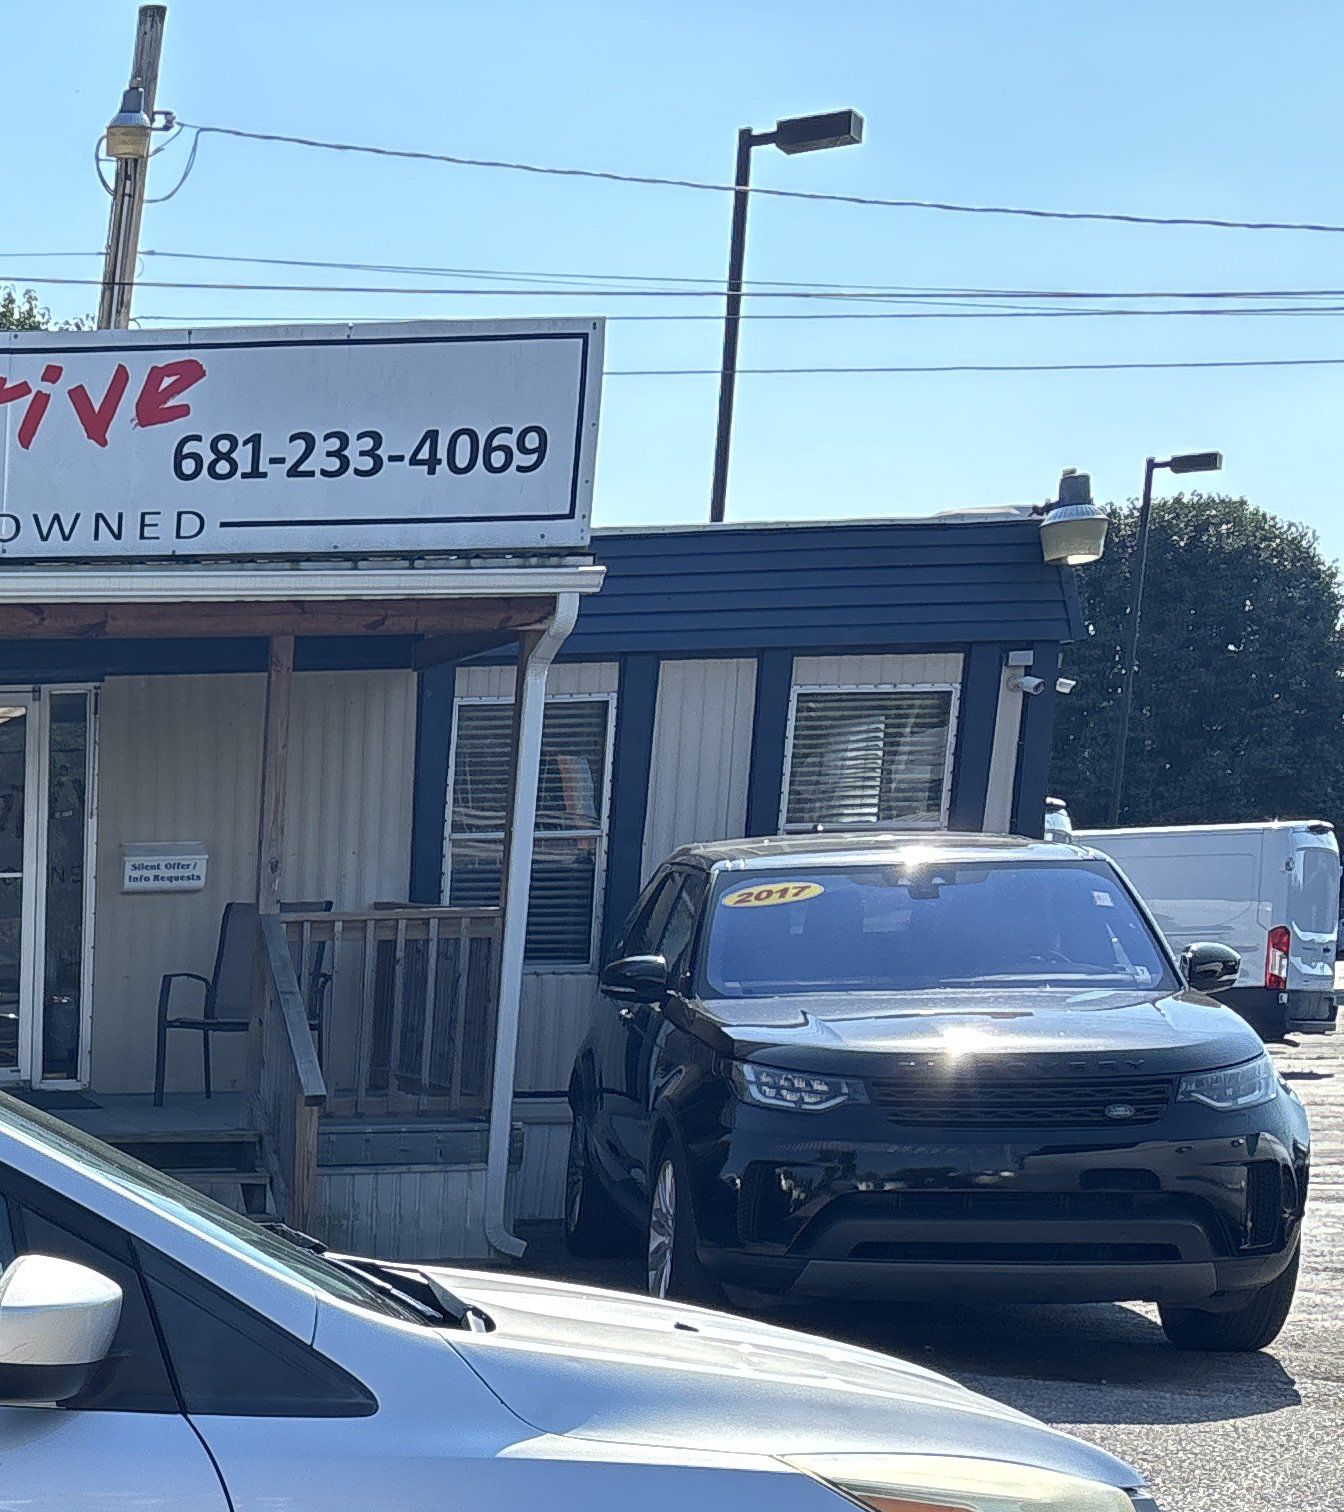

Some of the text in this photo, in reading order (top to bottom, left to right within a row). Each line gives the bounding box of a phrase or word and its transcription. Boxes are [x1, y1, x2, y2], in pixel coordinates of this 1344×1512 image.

[172, 425, 549, 481] 681-233-4069
[130, 862, 161, 871] Silent
[164, 861, 191, 871] Offer
[128, 873, 202, 883] Info Requests
[732, 884, 812, 905] 2017
